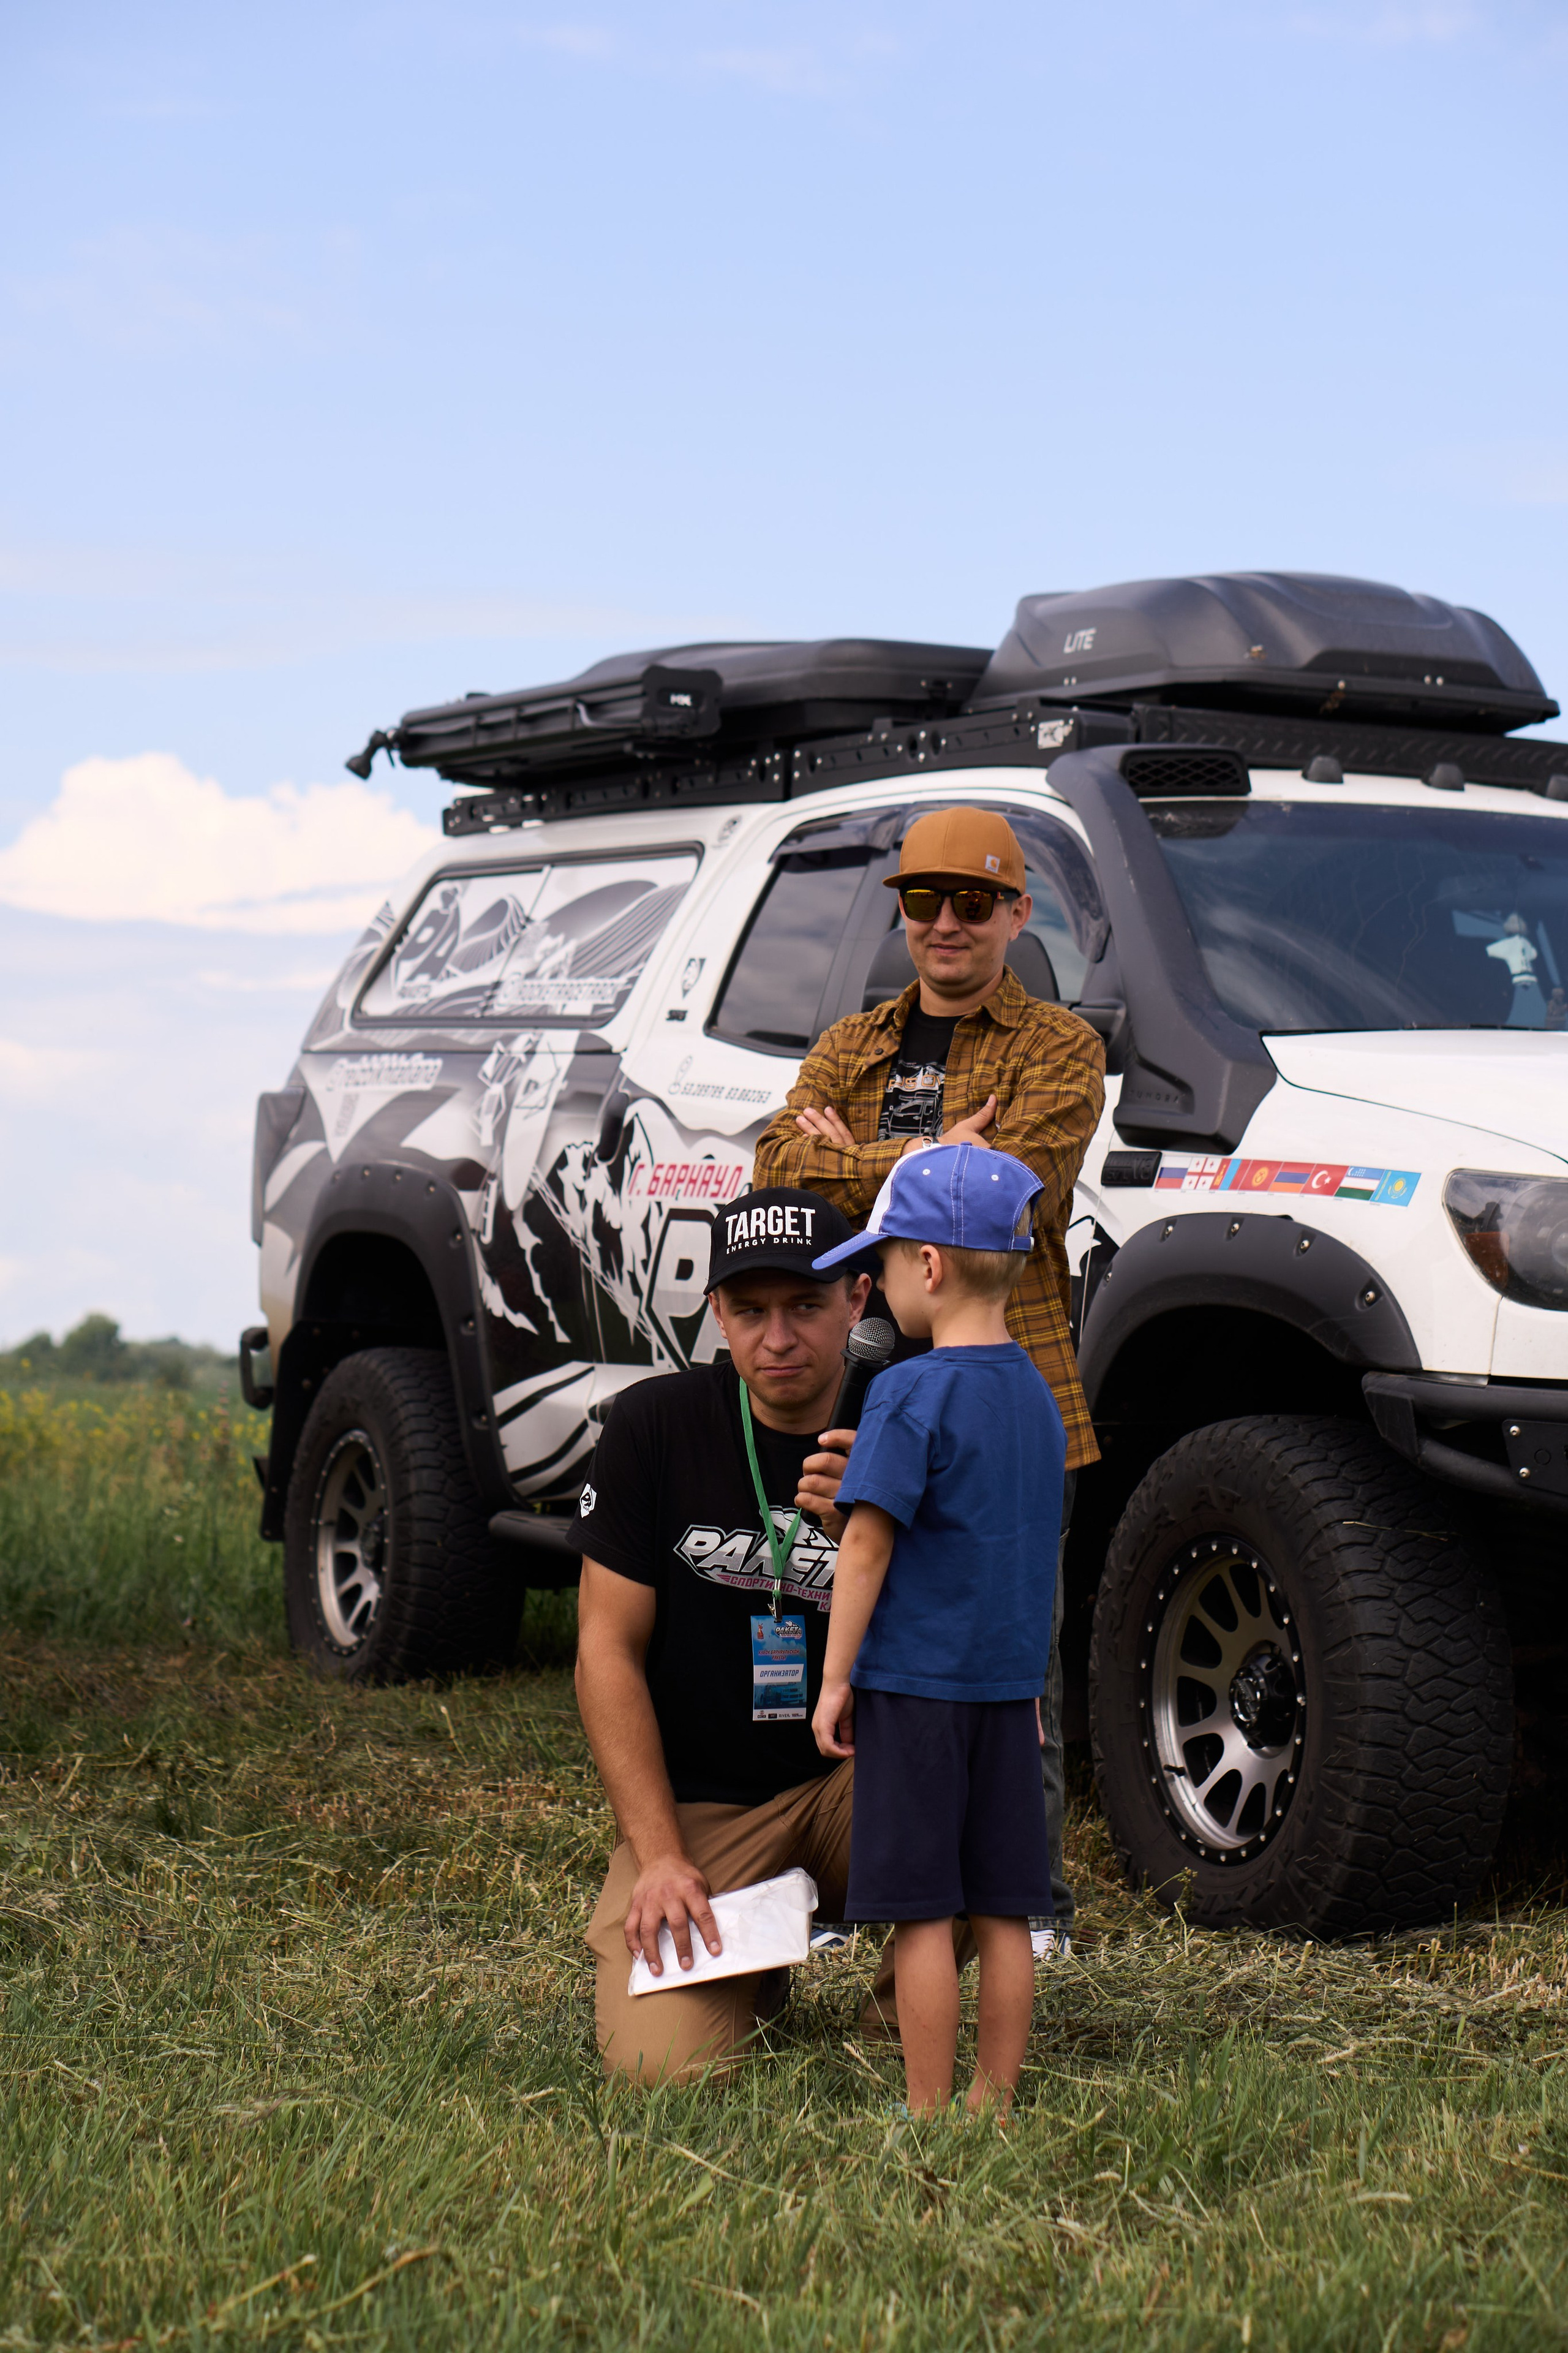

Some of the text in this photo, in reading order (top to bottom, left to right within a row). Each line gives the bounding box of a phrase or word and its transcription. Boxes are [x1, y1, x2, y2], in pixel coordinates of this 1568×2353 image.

[1063, 627, 1096, 654] LITE
[647, 1164, 743, 1198] БАРНАУЛ
[725, 1206, 816, 1245] TARGET
[726, 1237, 812, 1255] ENERGY DRINK
[680, 1529, 839, 1586] РАКЕТ
